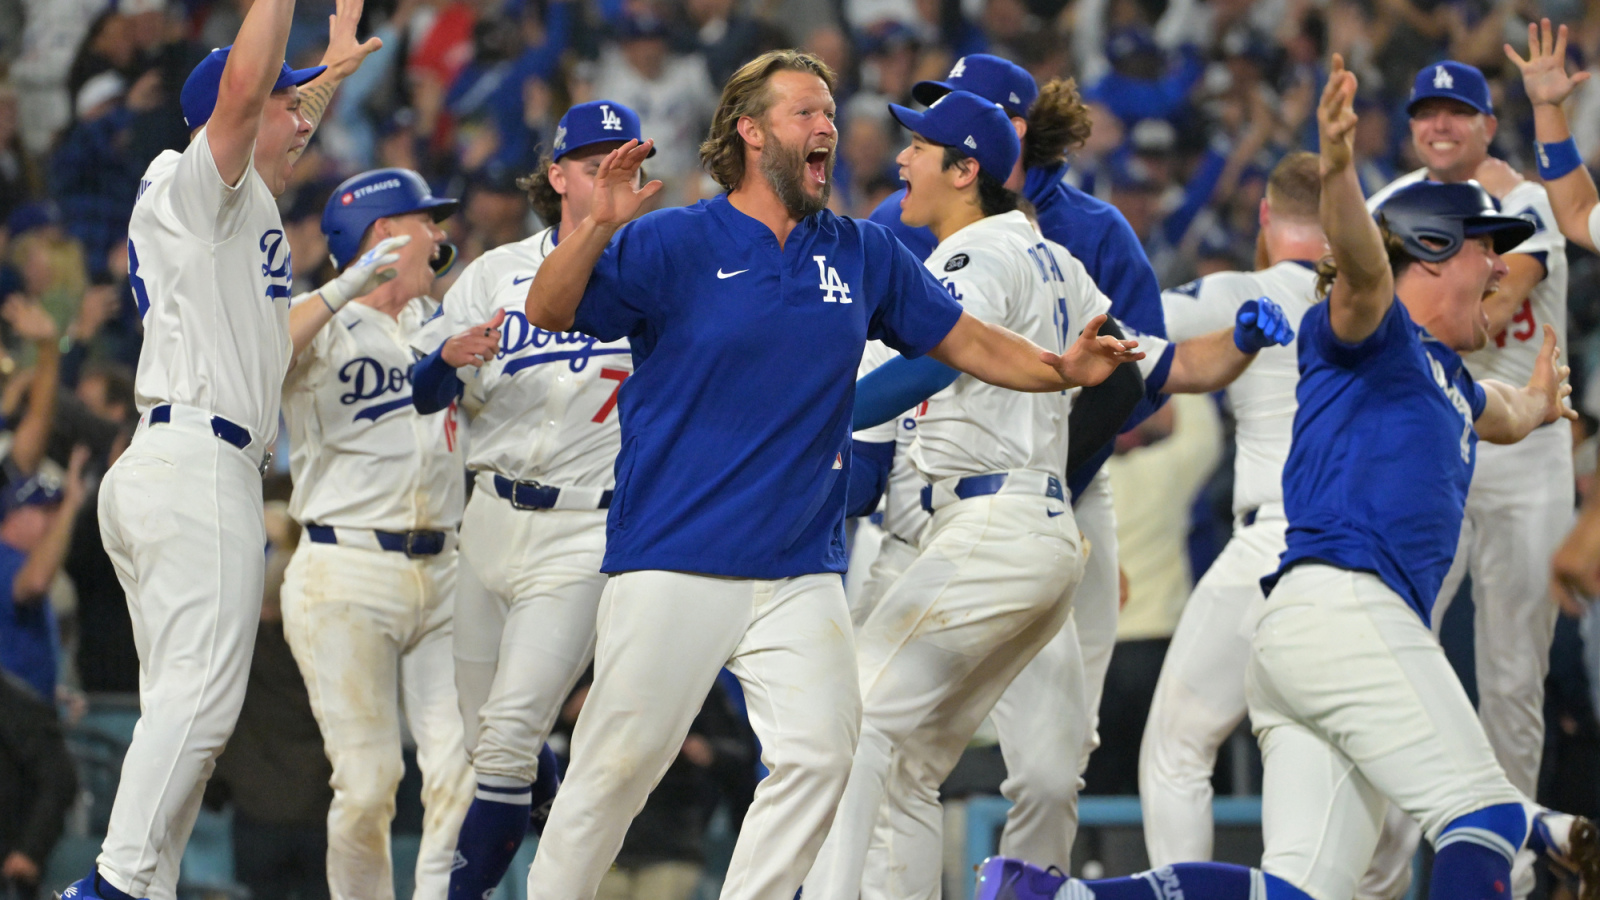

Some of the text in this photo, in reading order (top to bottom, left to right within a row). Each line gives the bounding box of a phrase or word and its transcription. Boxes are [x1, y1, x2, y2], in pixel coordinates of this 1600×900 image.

[1433, 65, 1454, 88] LA
[600, 105, 623, 130] LA
[353, 179, 401, 199] STRAUSS
[813, 255, 853, 304] LA
[591, 368, 629, 423] 7
